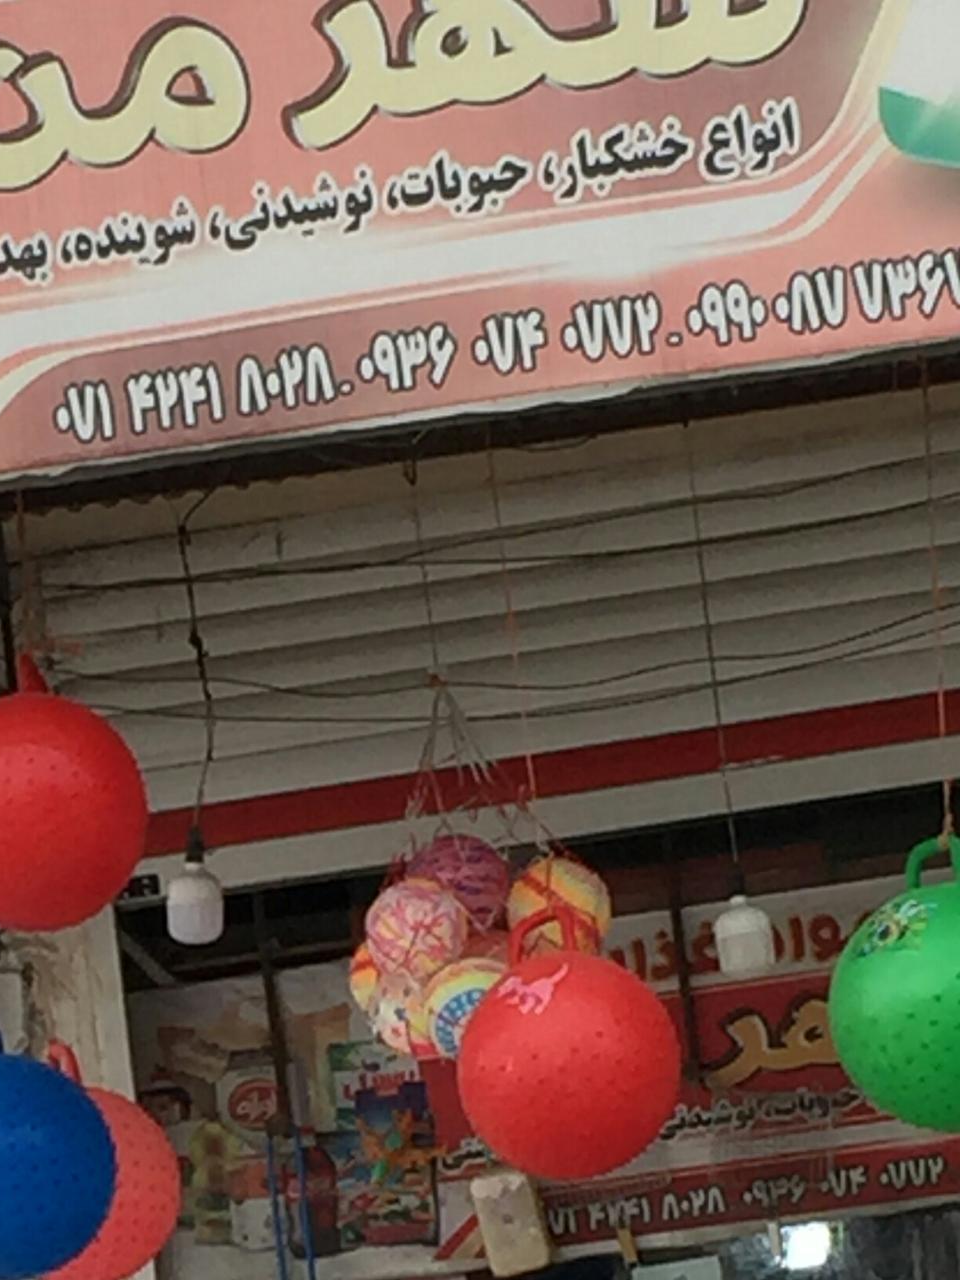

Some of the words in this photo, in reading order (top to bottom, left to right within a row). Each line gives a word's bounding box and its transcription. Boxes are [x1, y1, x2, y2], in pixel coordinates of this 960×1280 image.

[543, 121, 688, 198] خشکبار،
[705, 103, 797, 174] انواع
[209, 172, 373, 247] نوشیدنی،
[388, 157, 526, 211] حبوبات،
[62, 204, 196, 264] شوینده،
[127, 360, 223, 435] ۴۲۴۱
[358, 324, 457, 393] ۰۹۳۶
[474, 310, 545, 375] ۰۷۴
[547, 1202, 578, 1235] ۷۱
